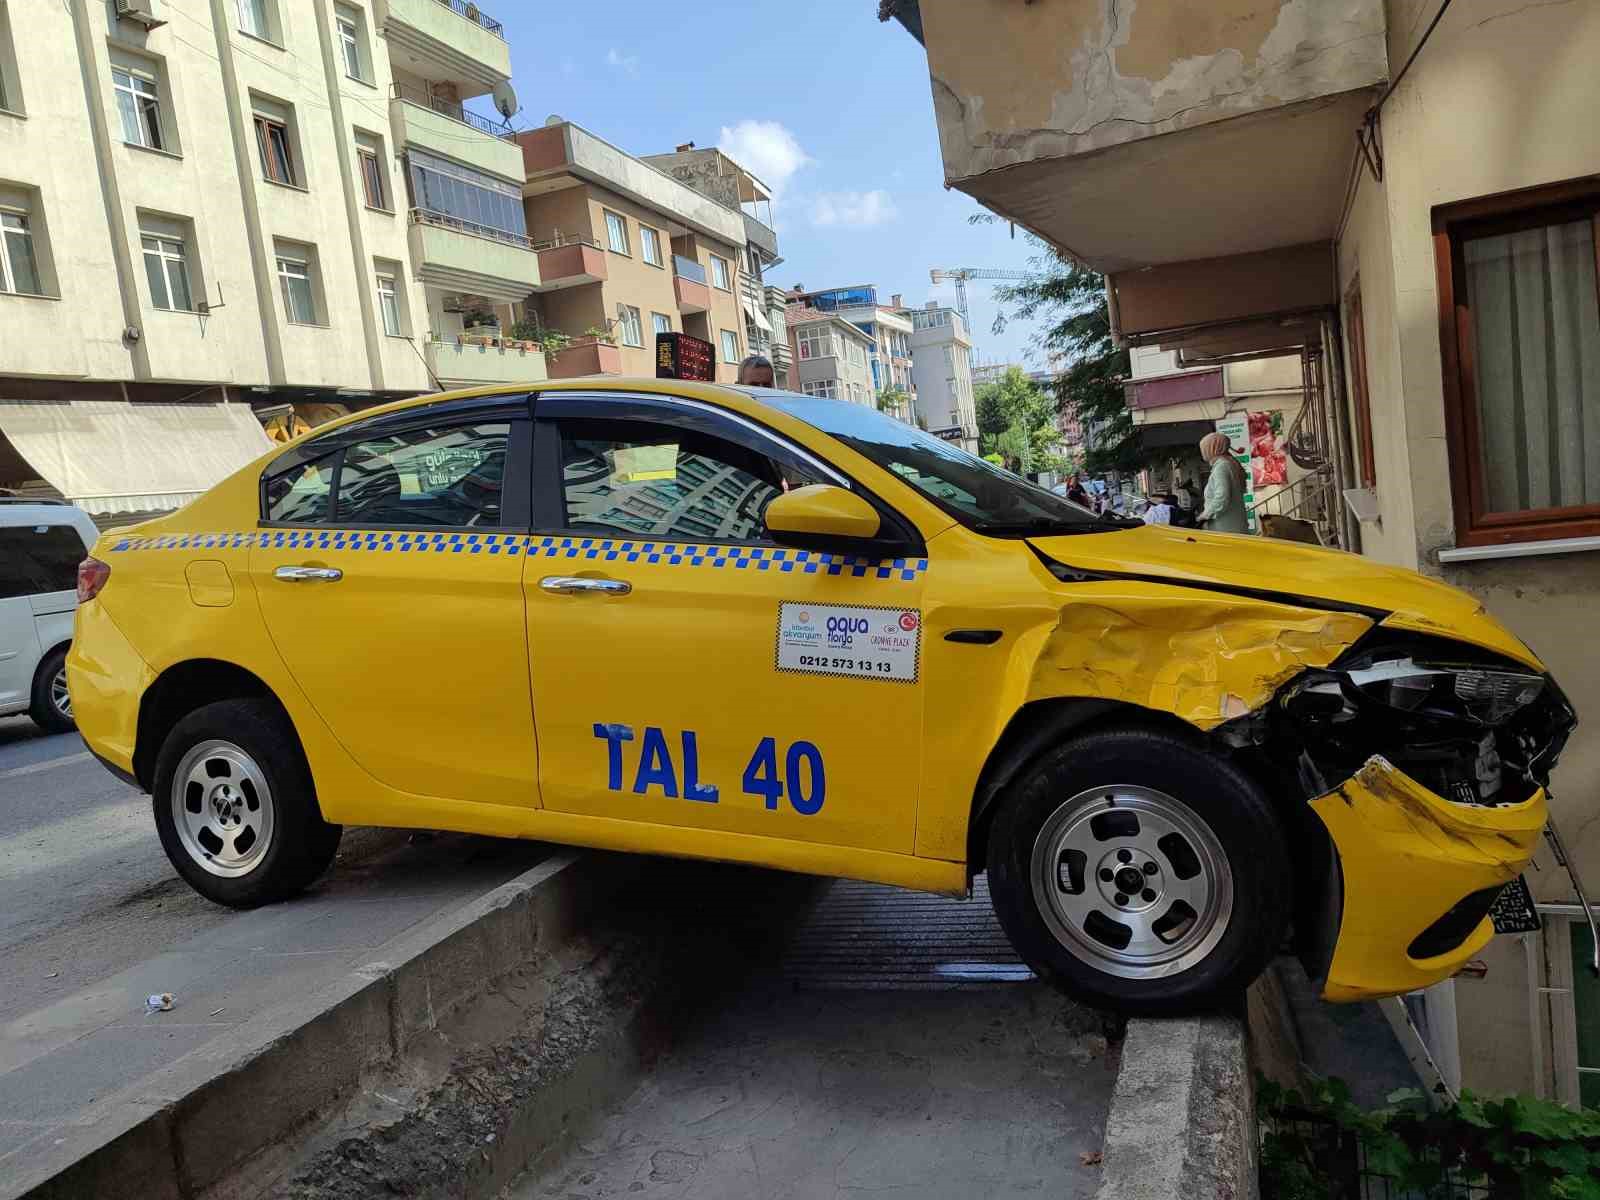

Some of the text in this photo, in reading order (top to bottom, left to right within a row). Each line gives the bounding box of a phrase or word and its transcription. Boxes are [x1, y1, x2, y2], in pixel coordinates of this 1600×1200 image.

[826, 616, 868, 637] aqua
[799, 655, 891, 673] 0212 573 13 13
[593, 723, 826, 815] TAL 40
